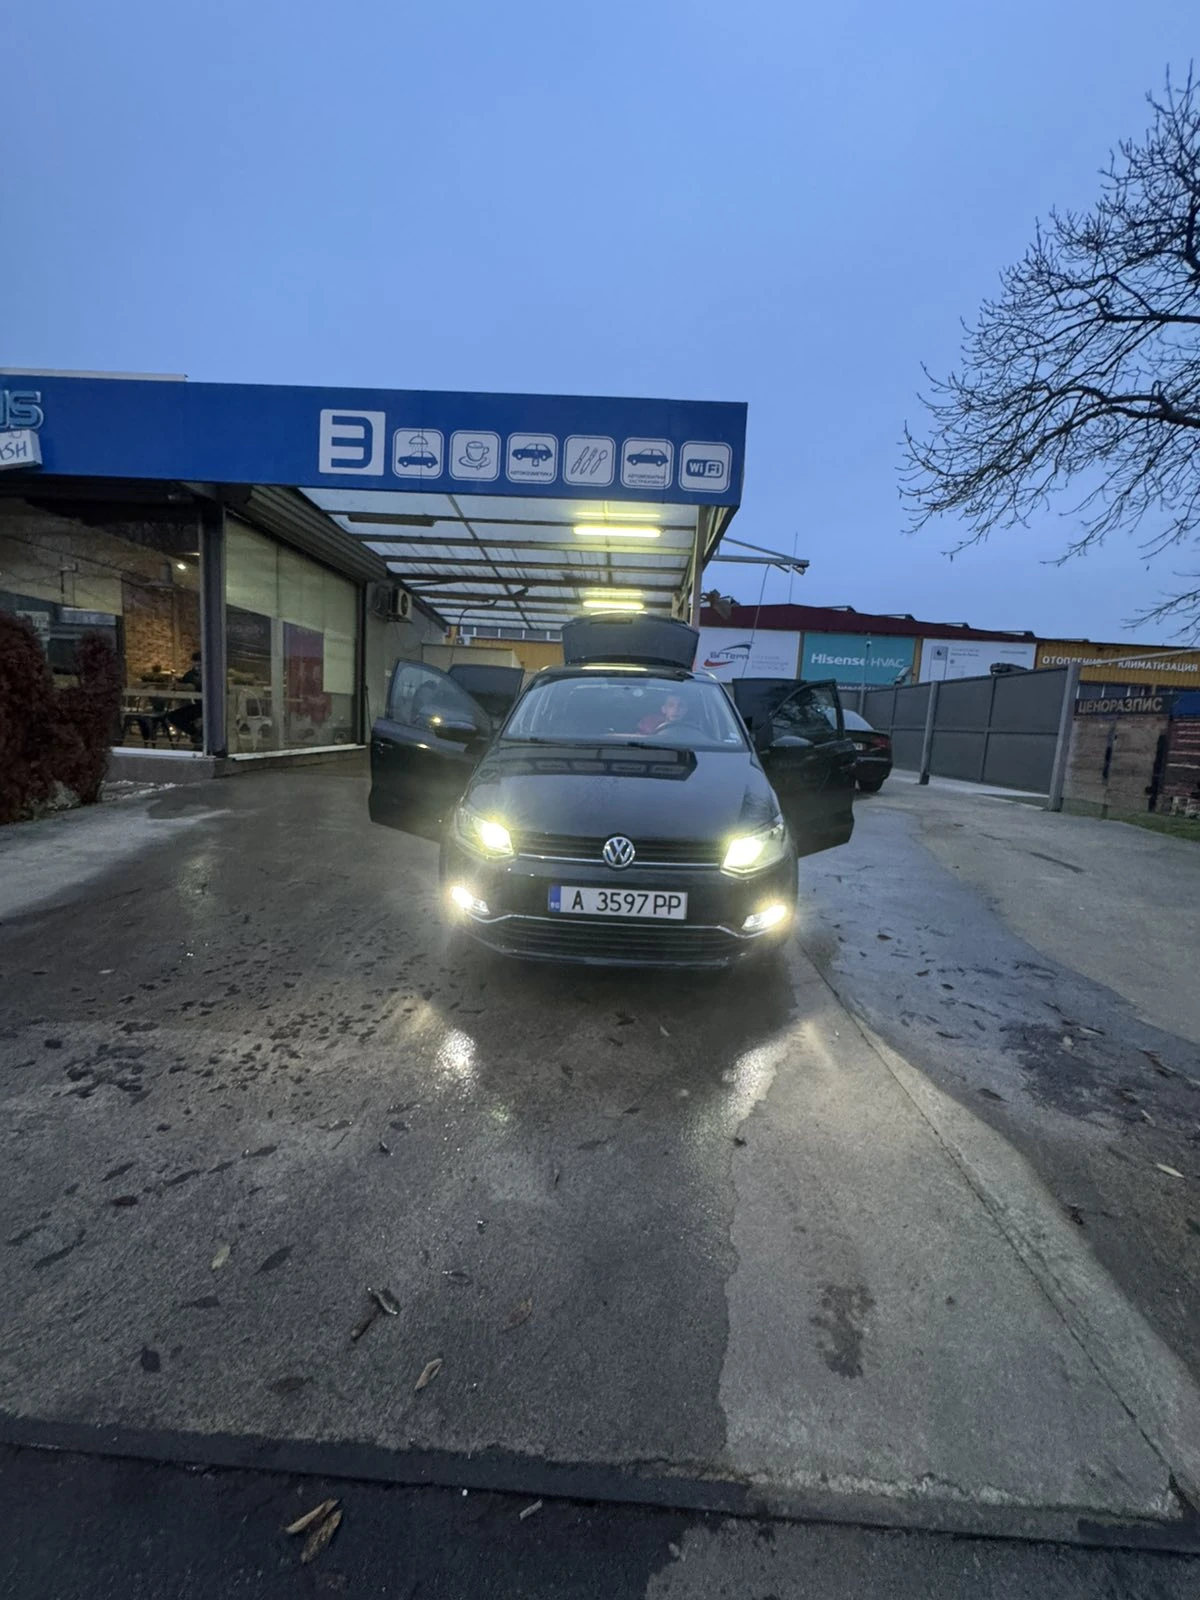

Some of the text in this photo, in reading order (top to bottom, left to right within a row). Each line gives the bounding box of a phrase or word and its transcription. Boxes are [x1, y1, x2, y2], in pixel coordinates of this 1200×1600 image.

[811, 653, 904, 668] Hisense HVAC
[1078, 697, 1163, 713] ЦЕНОРАЗПИС
[571, 890, 584, 911] A
